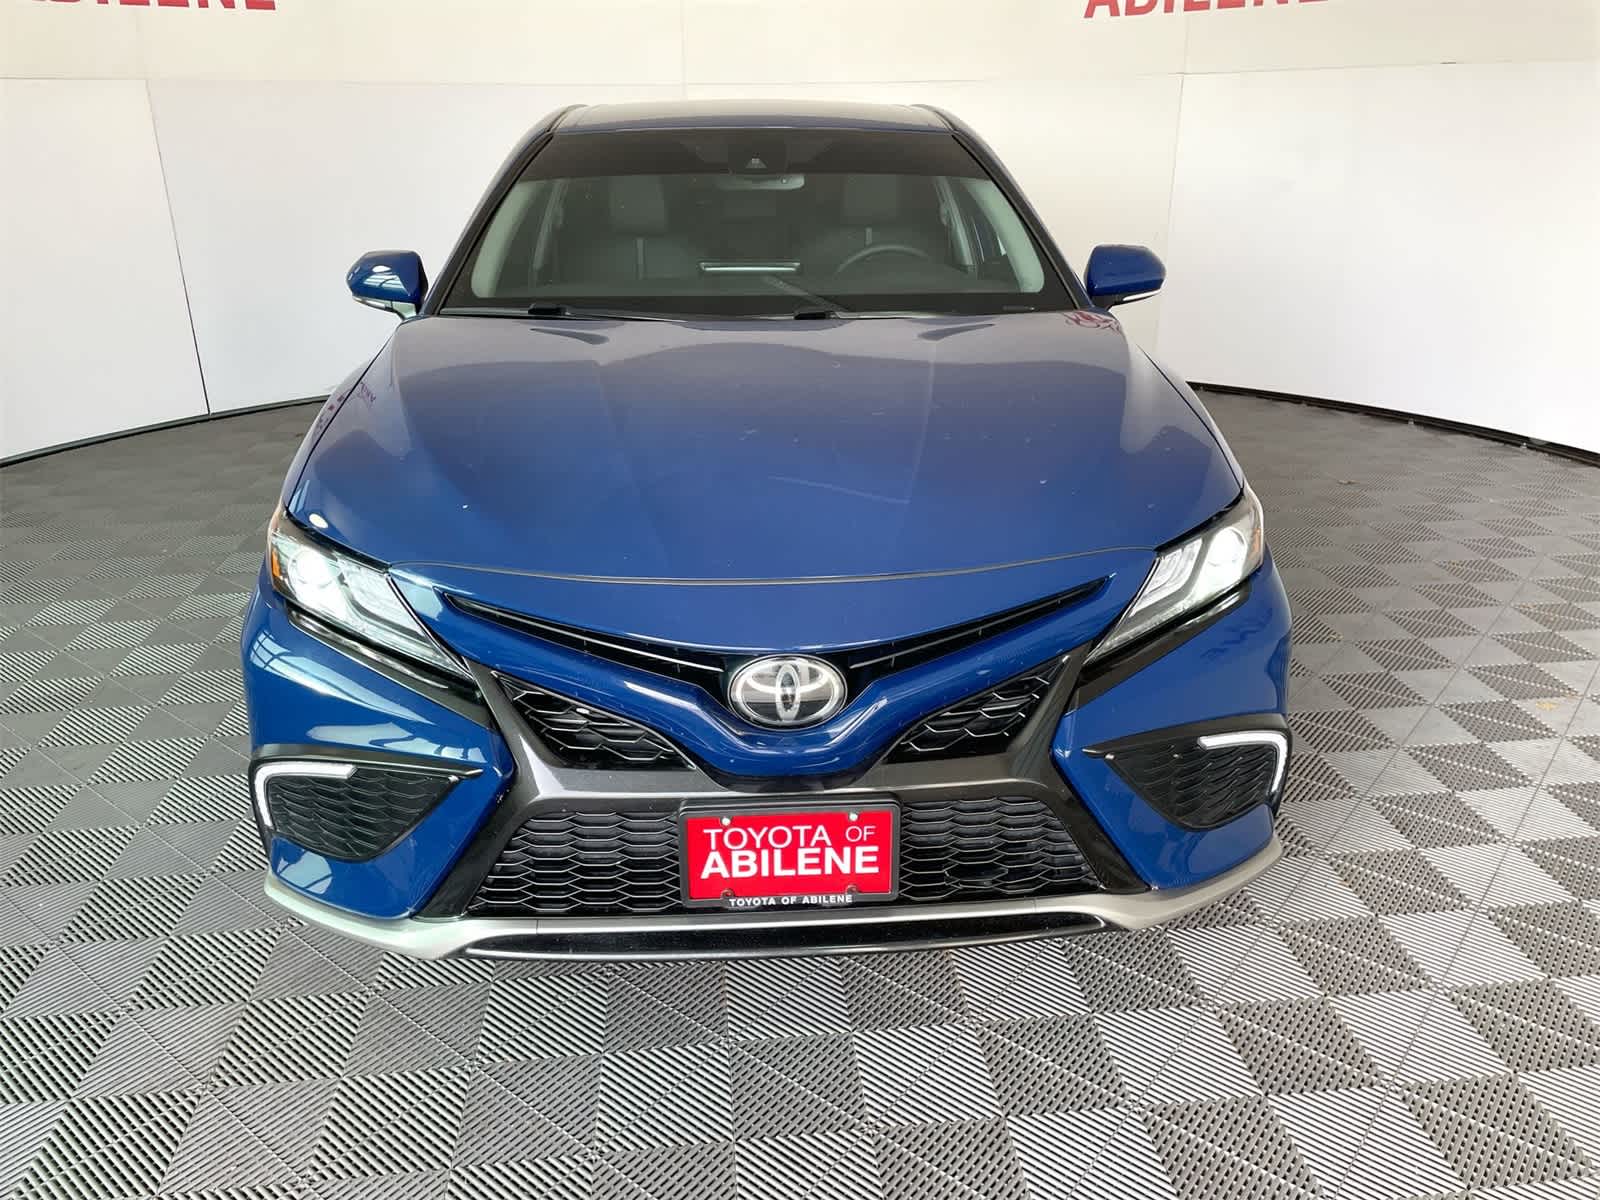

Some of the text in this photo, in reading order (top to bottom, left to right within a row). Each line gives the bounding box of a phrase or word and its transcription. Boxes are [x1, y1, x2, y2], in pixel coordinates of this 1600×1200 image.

[703, 825, 876, 850] TOYOTA OF
[700, 846, 879, 879] ABILENE
[729, 894, 853, 907] TOYOTA OF ABILENE
